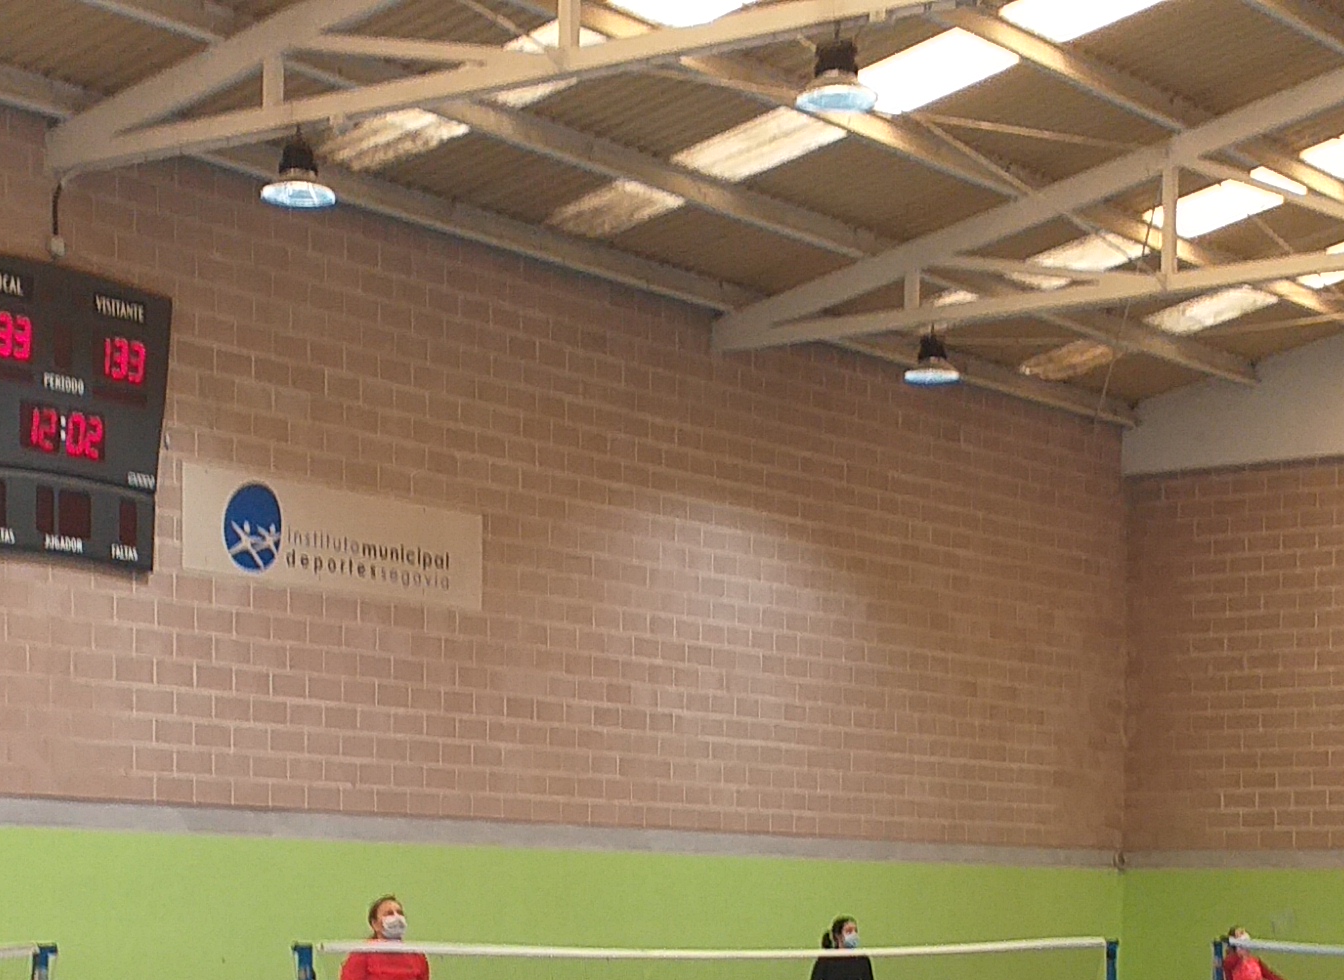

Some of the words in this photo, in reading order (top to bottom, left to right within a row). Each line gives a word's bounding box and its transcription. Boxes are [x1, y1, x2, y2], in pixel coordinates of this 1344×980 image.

[95, 294, 145, 323] VISITANTE
[104, 336, 146, 385] 133
[43, 372, 85, 396] PERIODO
[30, 407, 103, 462] 12:02
[44, 533, 83, 553] JUGADOR
[111, 544, 138, 562] FALTAS
